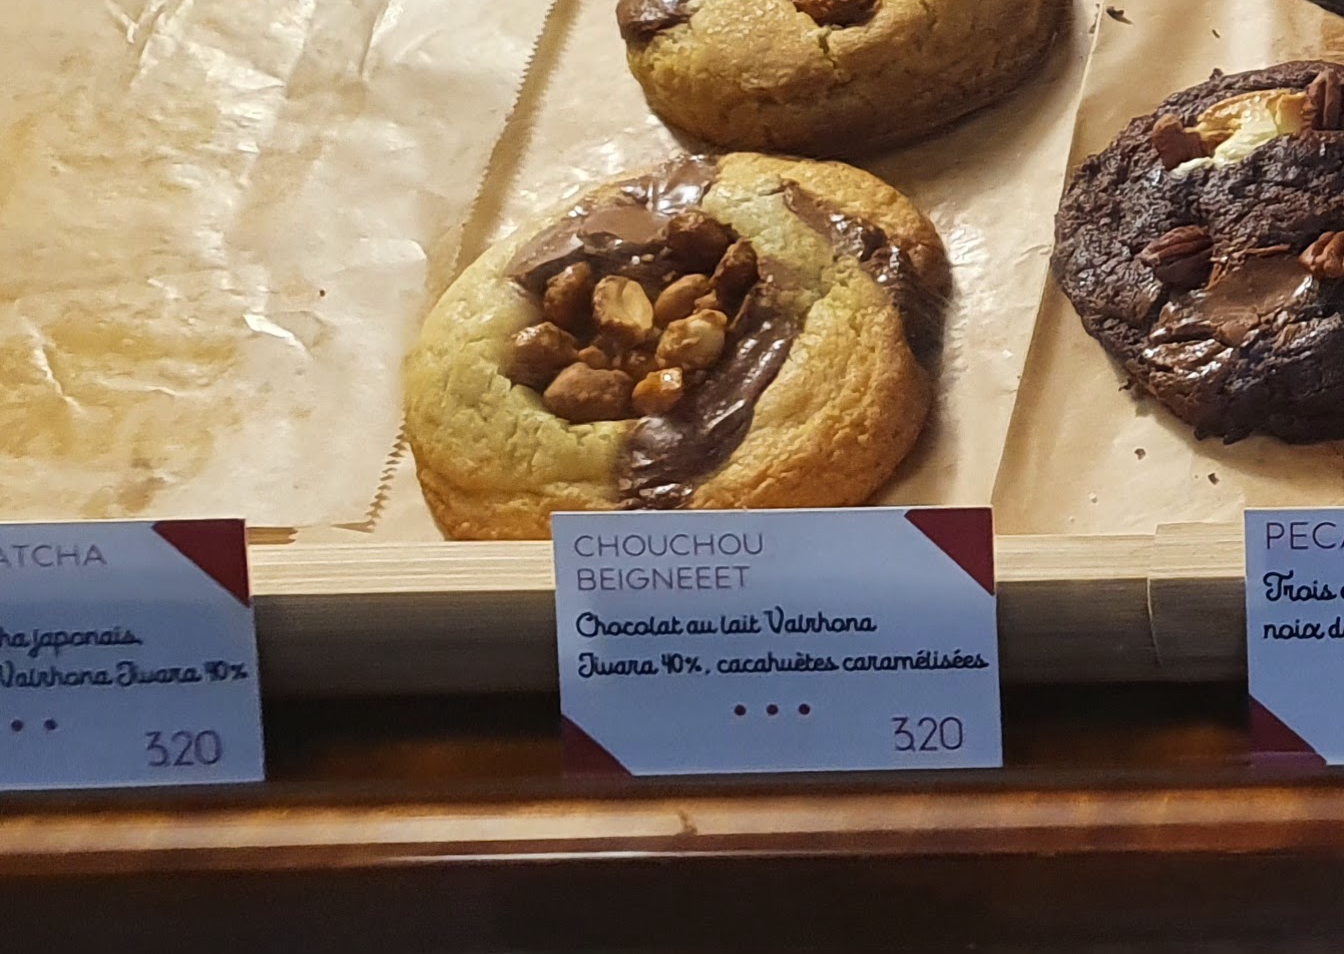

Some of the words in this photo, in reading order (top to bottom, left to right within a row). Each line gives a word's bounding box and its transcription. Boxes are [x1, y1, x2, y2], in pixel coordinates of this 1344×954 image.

[573, 533, 764, 558] CHOUCHOU
[576, 565, 751, 591] BEIGNEEET
[1262, 569, 1337, 603] Trois
[575, 611, 684, 638] Chocolat
[685, 618, 718, 634] au
[719, 613, 761, 635] lait
[763, 606, 878, 634] Valrhona
[1262, 619, 1325, 641] noix
[577, 651, 659, 678] Jivara
[716, 650, 840, 673] cacahuètes
[841, 648, 990, 672] caramélisées
